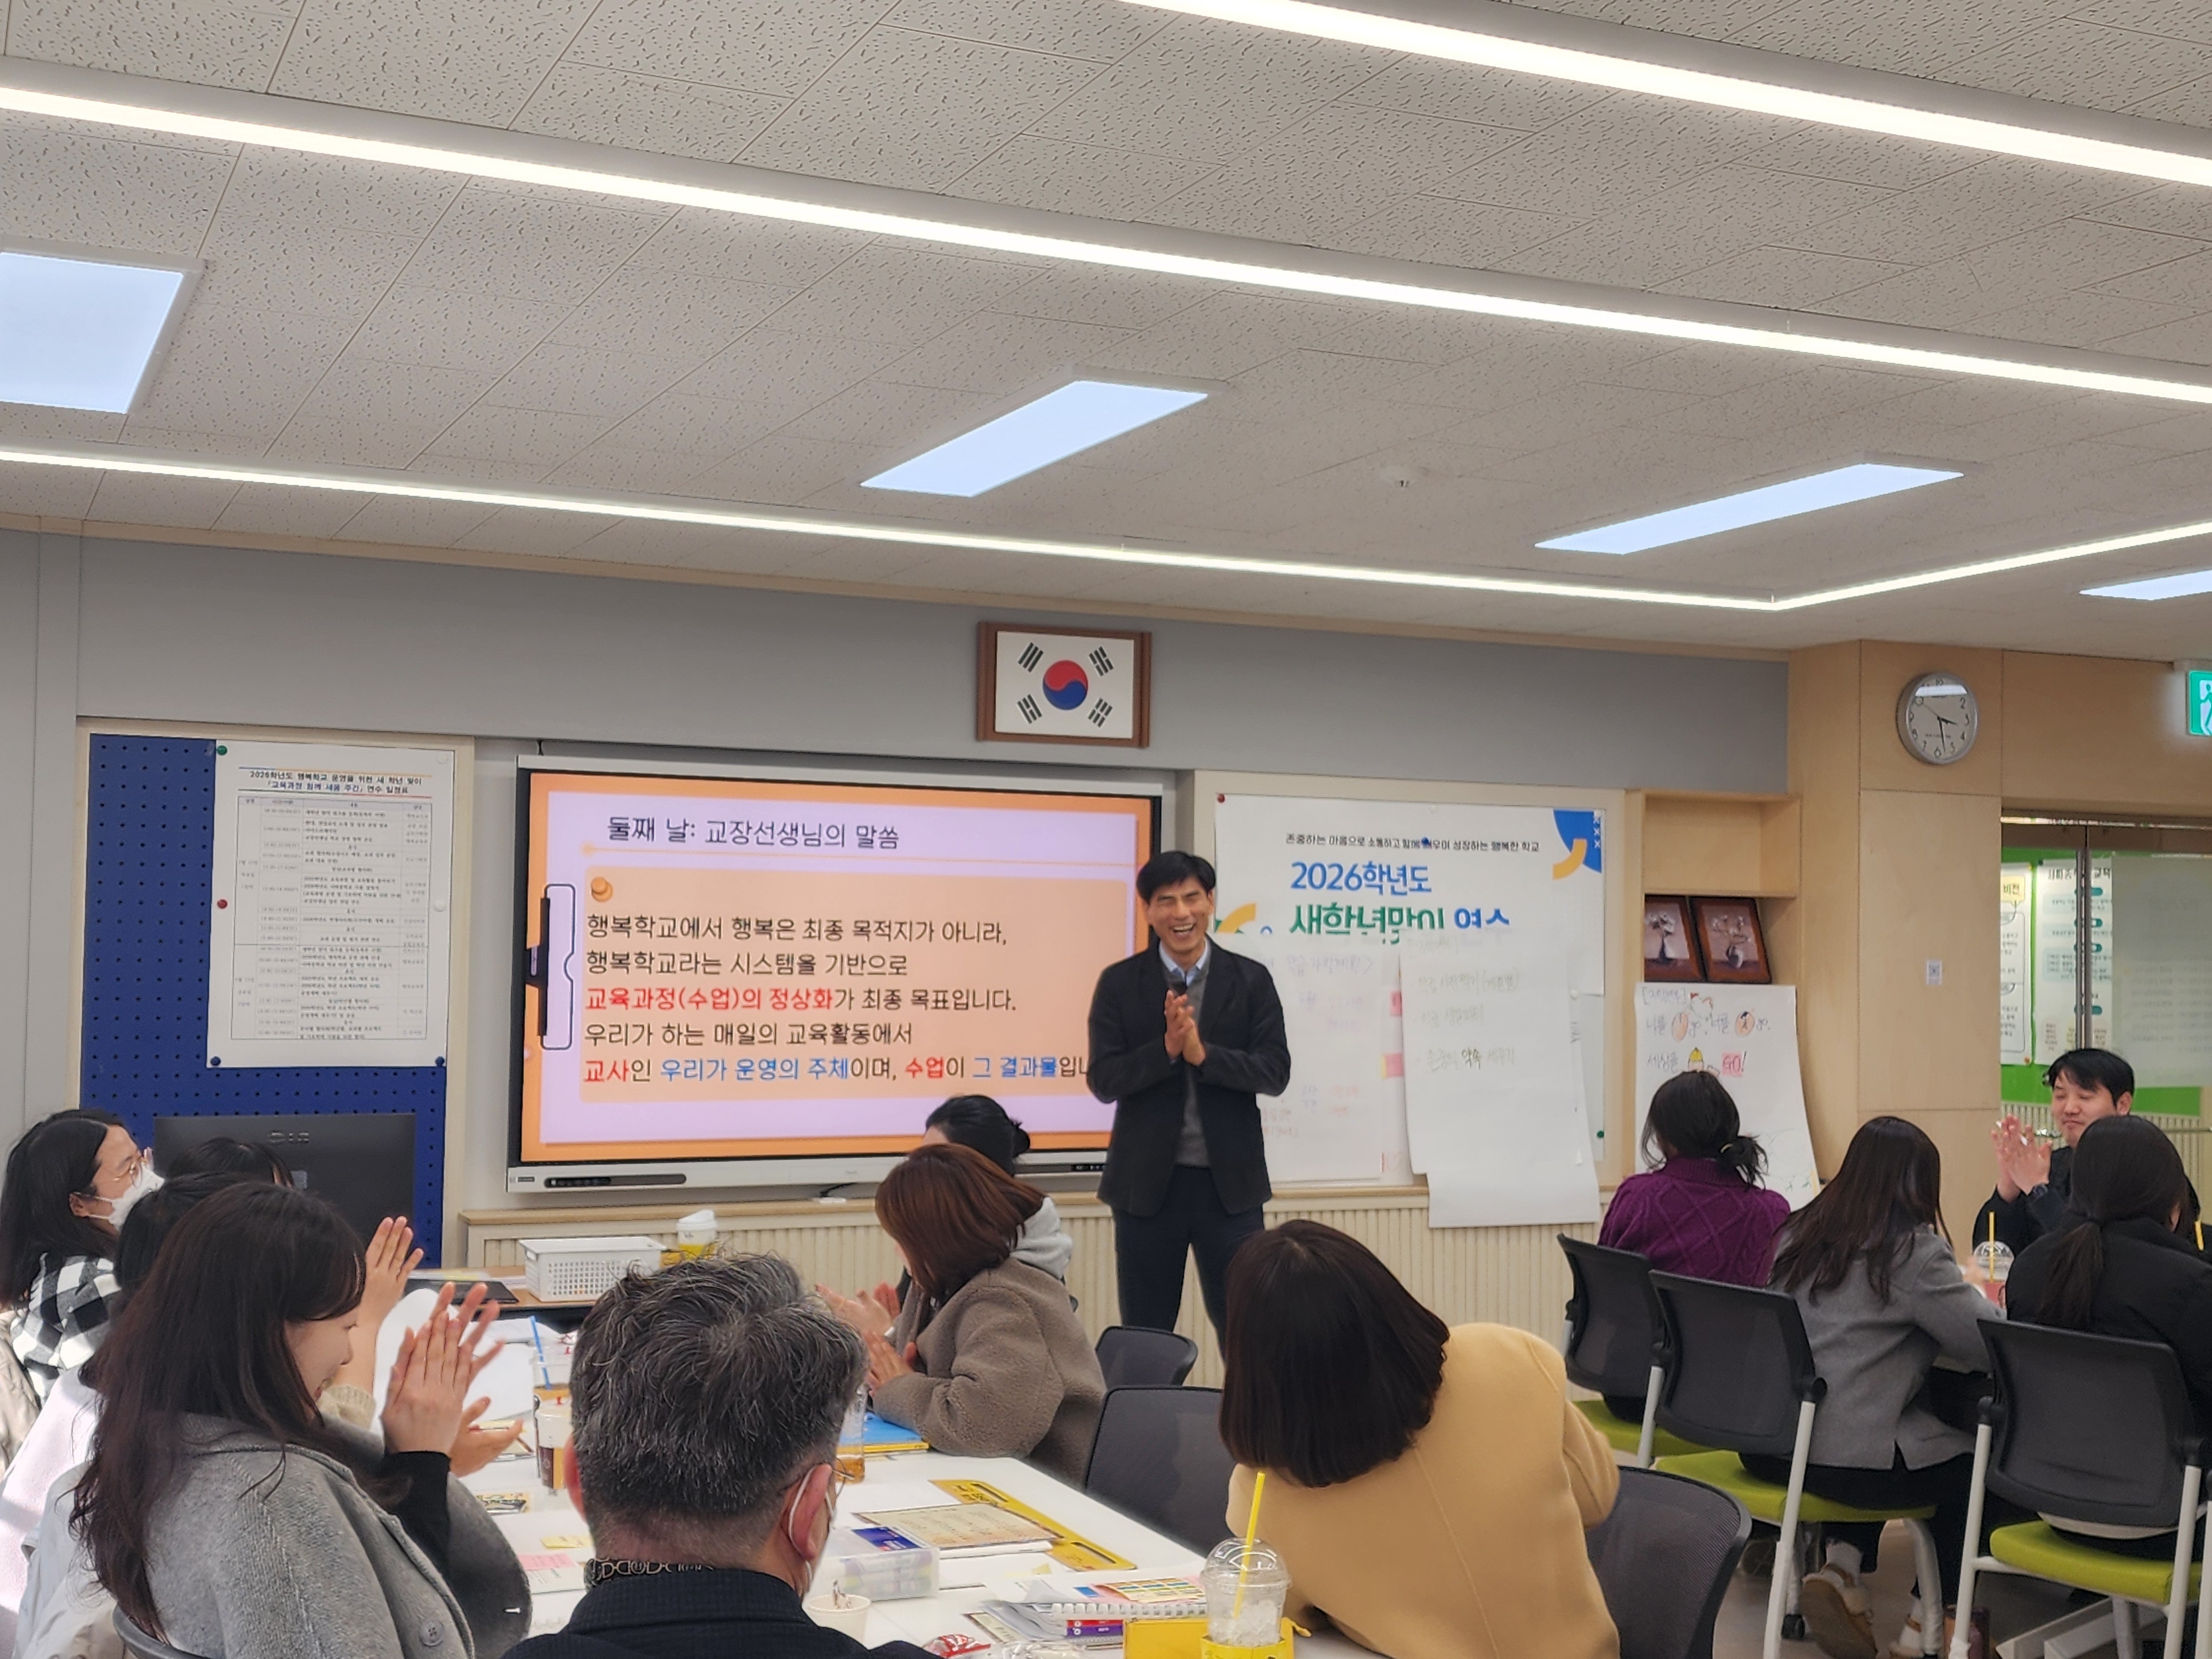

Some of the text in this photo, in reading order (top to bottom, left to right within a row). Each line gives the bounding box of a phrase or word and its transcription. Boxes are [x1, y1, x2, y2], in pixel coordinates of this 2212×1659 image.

[607, 816, 900, 850] 둘째 날: 교장선생님의 말씀
[1286, 833, 1326, 846] 존중하는
[1329, 835, 1365, 847] 마음으로
[1368, 837, 1401, 849] 소통하고
[1453, 840, 1488, 852] 성장하는
[1491, 841, 1519, 852] 행복한
[1522, 842, 1540, 853] 학교
[1290, 860, 1432, 896] 2026학년도
[586, 914, 1008, 946] 행복학교에서 행복은 최종 목적지가 아니라,
[586, 950, 909, 976] 행복학교라는 시스템을 기반으로
[585, 986, 1017, 1011] 교육과정(수업)의 정상화가 최종 목표입니다.
[584, 1022, 912, 1047] 우리가 하는 매일의 교육활동에서
[583, 1059, 651, 1083] 교사인
[660, 1057, 728, 1082] 우리가
[734, 1057, 799, 1082] 운영의
[807, 1057, 898, 1081] 주체이며,
[904, 1056, 965, 1079] 수업이
[972, 1057, 992, 1078] 그
[1462, 1047, 1483, 1070] 약속
